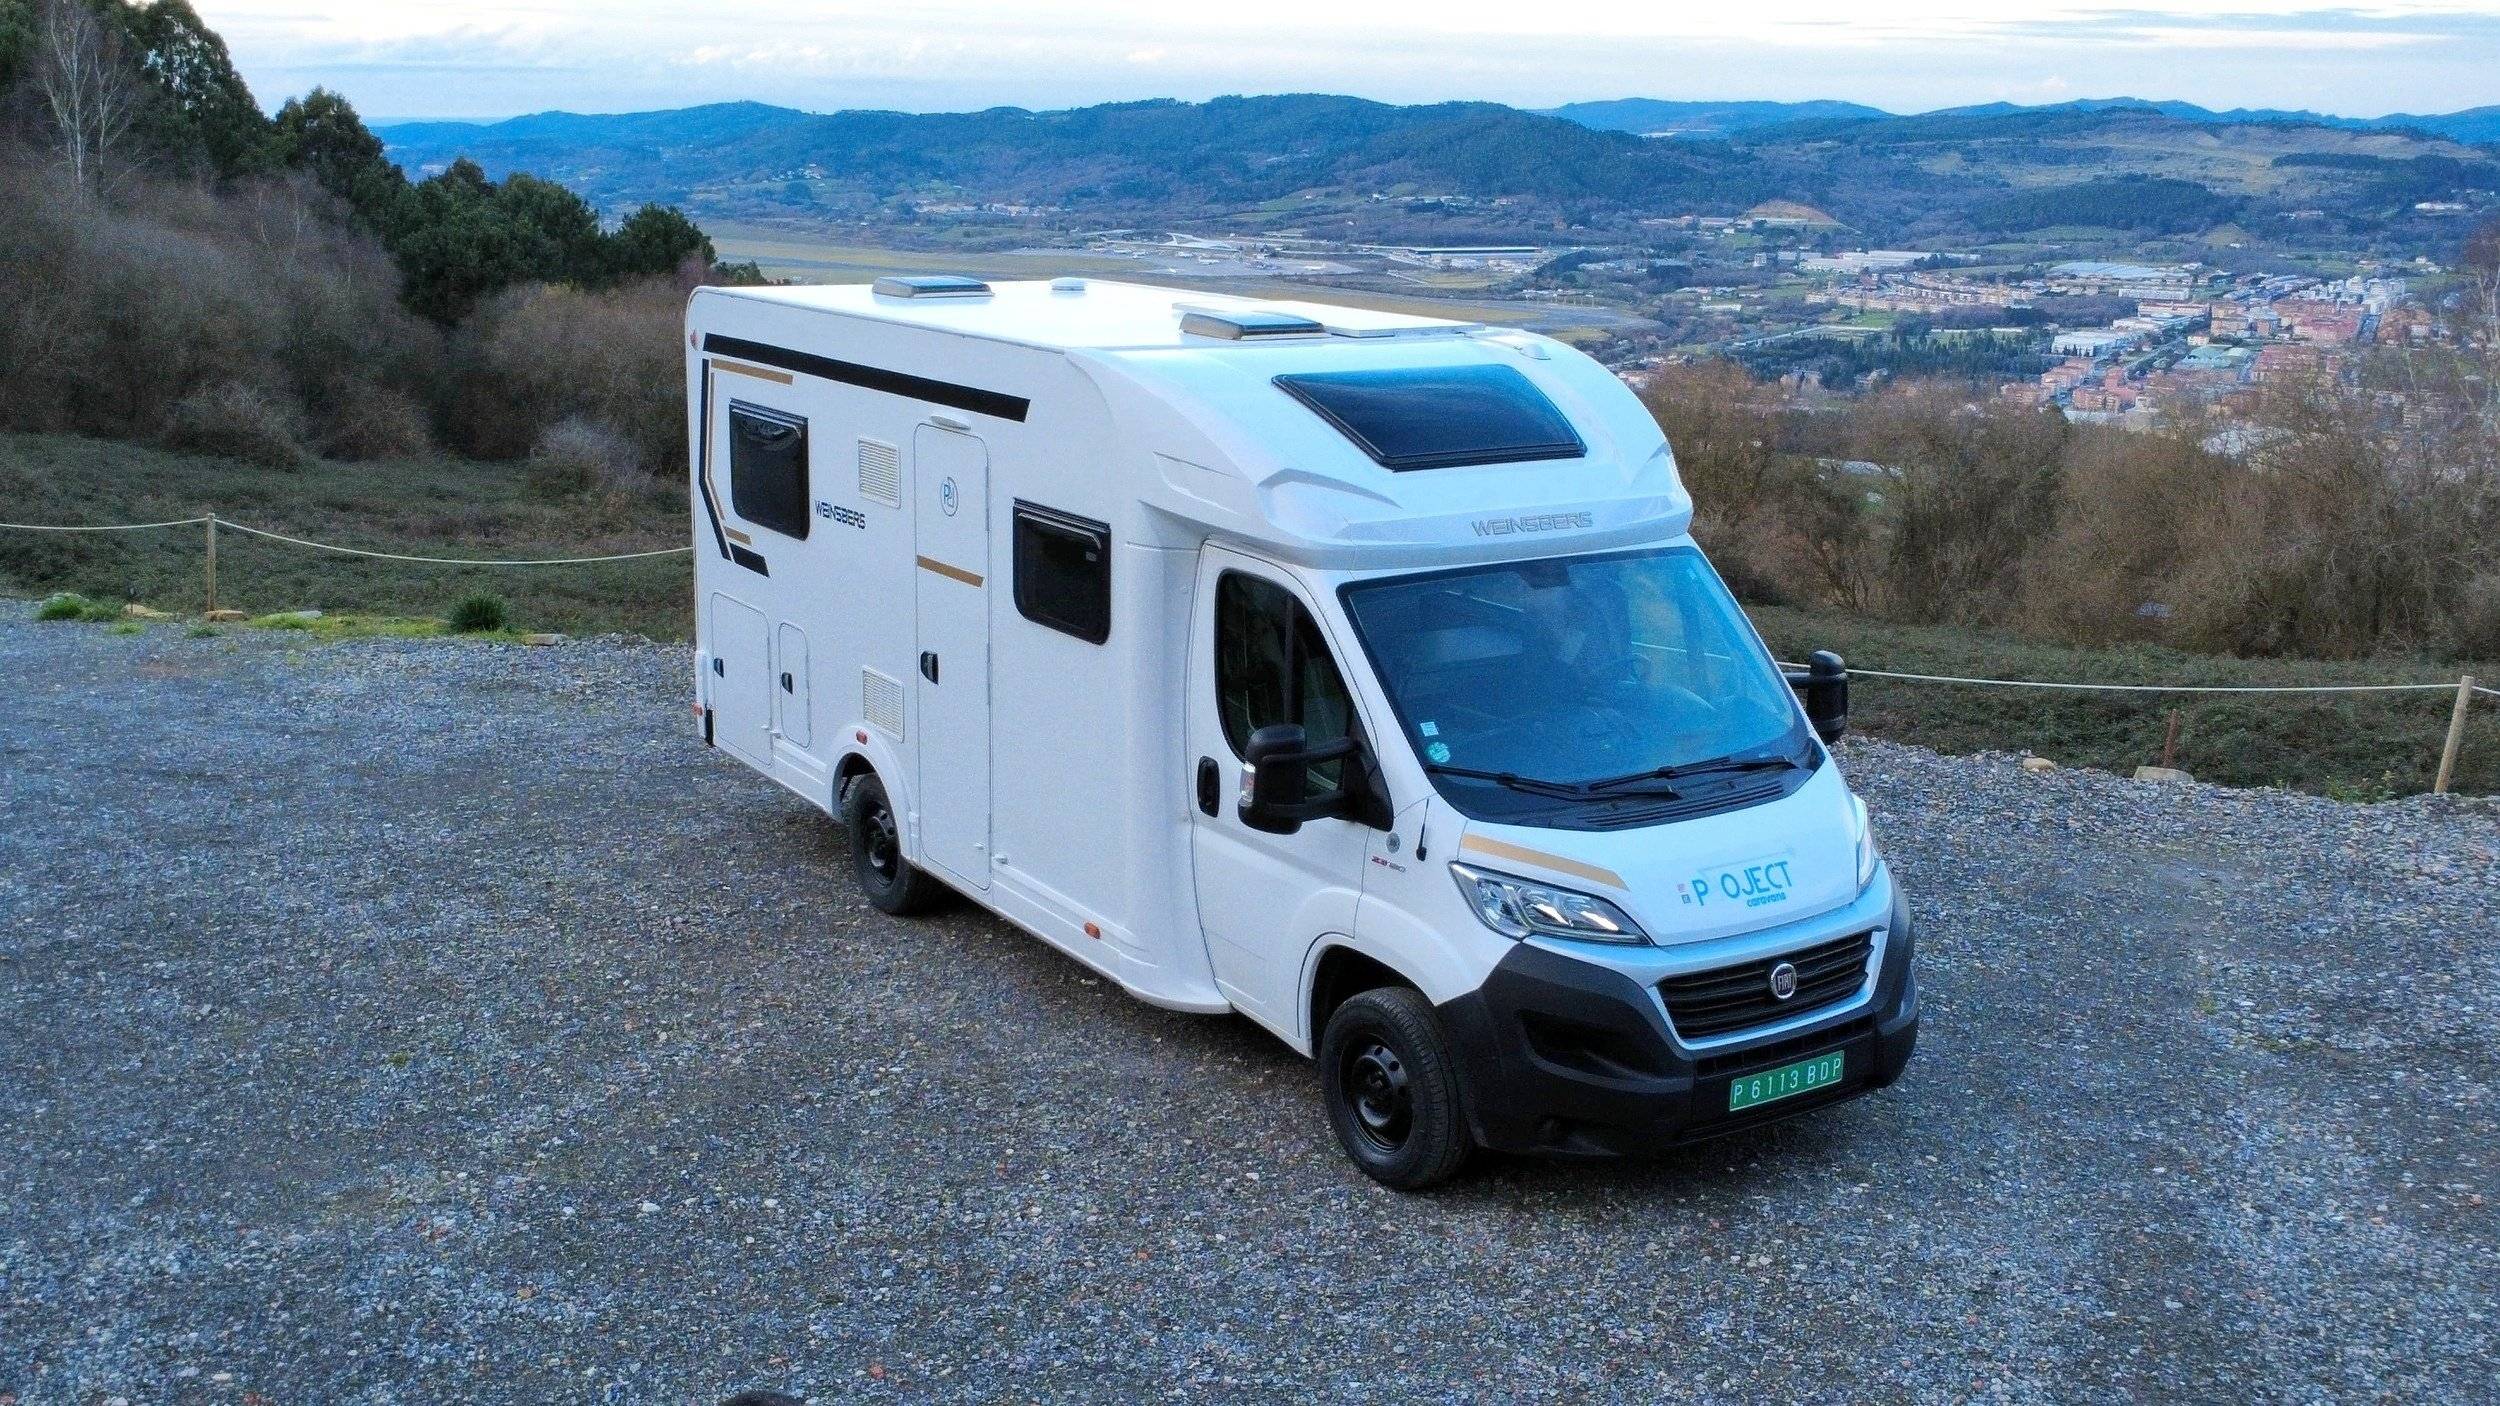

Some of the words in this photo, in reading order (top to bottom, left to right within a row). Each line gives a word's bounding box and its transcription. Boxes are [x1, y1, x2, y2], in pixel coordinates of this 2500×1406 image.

[1470, 511, 1592, 537] WEINSBERG
[1777, 973, 1792, 992] FIAT
[1732, 1084, 1744, 1104] P
[1751, 1070, 1799, 1100] 6113
[1807, 1058, 1842, 1085] BDP
